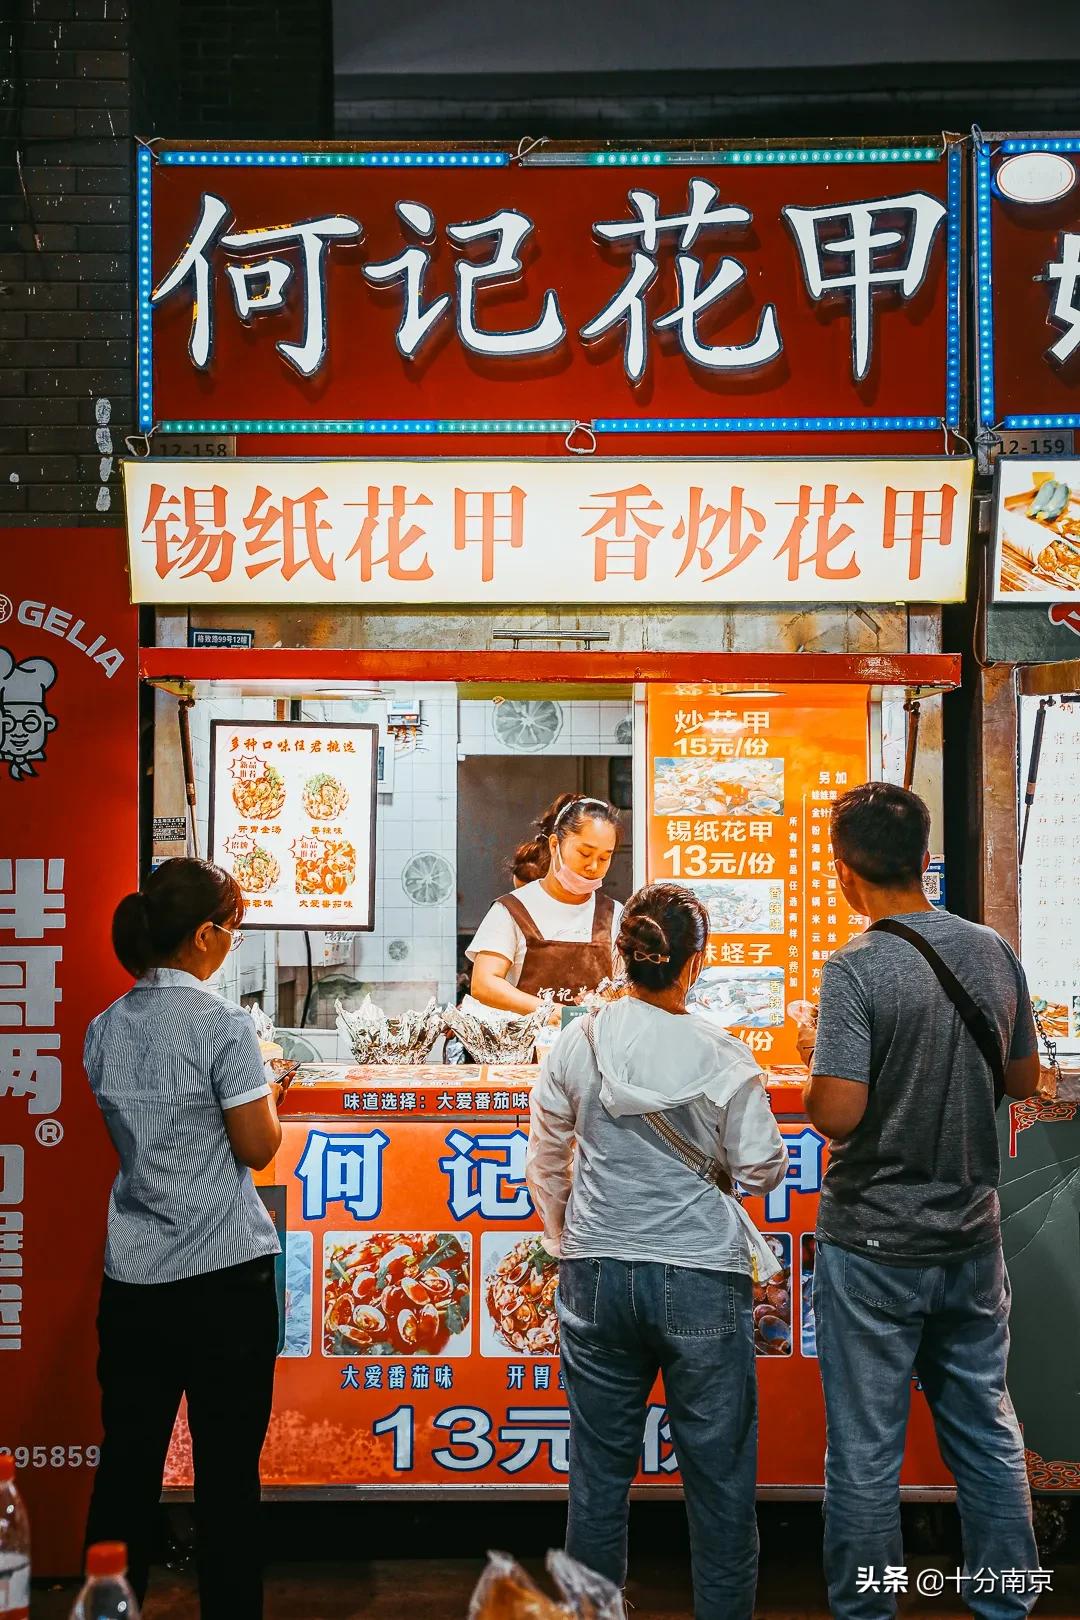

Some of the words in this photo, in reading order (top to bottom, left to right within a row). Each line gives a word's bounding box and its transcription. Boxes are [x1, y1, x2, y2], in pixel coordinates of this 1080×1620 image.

[152, 177, 947, 382] 何记花甲
[160, 443, 227, 457] 12-158
[998, 440, 1065, 455] 12-159
[141, 484, 526, 582] 锡纸花甲
[579, 483, 959, 583] 香炒花甲
[17, 600, 125, 679] GELIA
[229, 736, 356, 753] 多种口味任君挑选
[673, 737, 769, 756] 15元/份
[819, 772, 847, 784] 另加
[666, 820, 773, 843] 锡纸花甲
[663, 845, 776, 876] 13元/份
[299, 900, 353, 908] 大爱番茄味
[341, 1365, 453, 1390] 大爱番茄味
